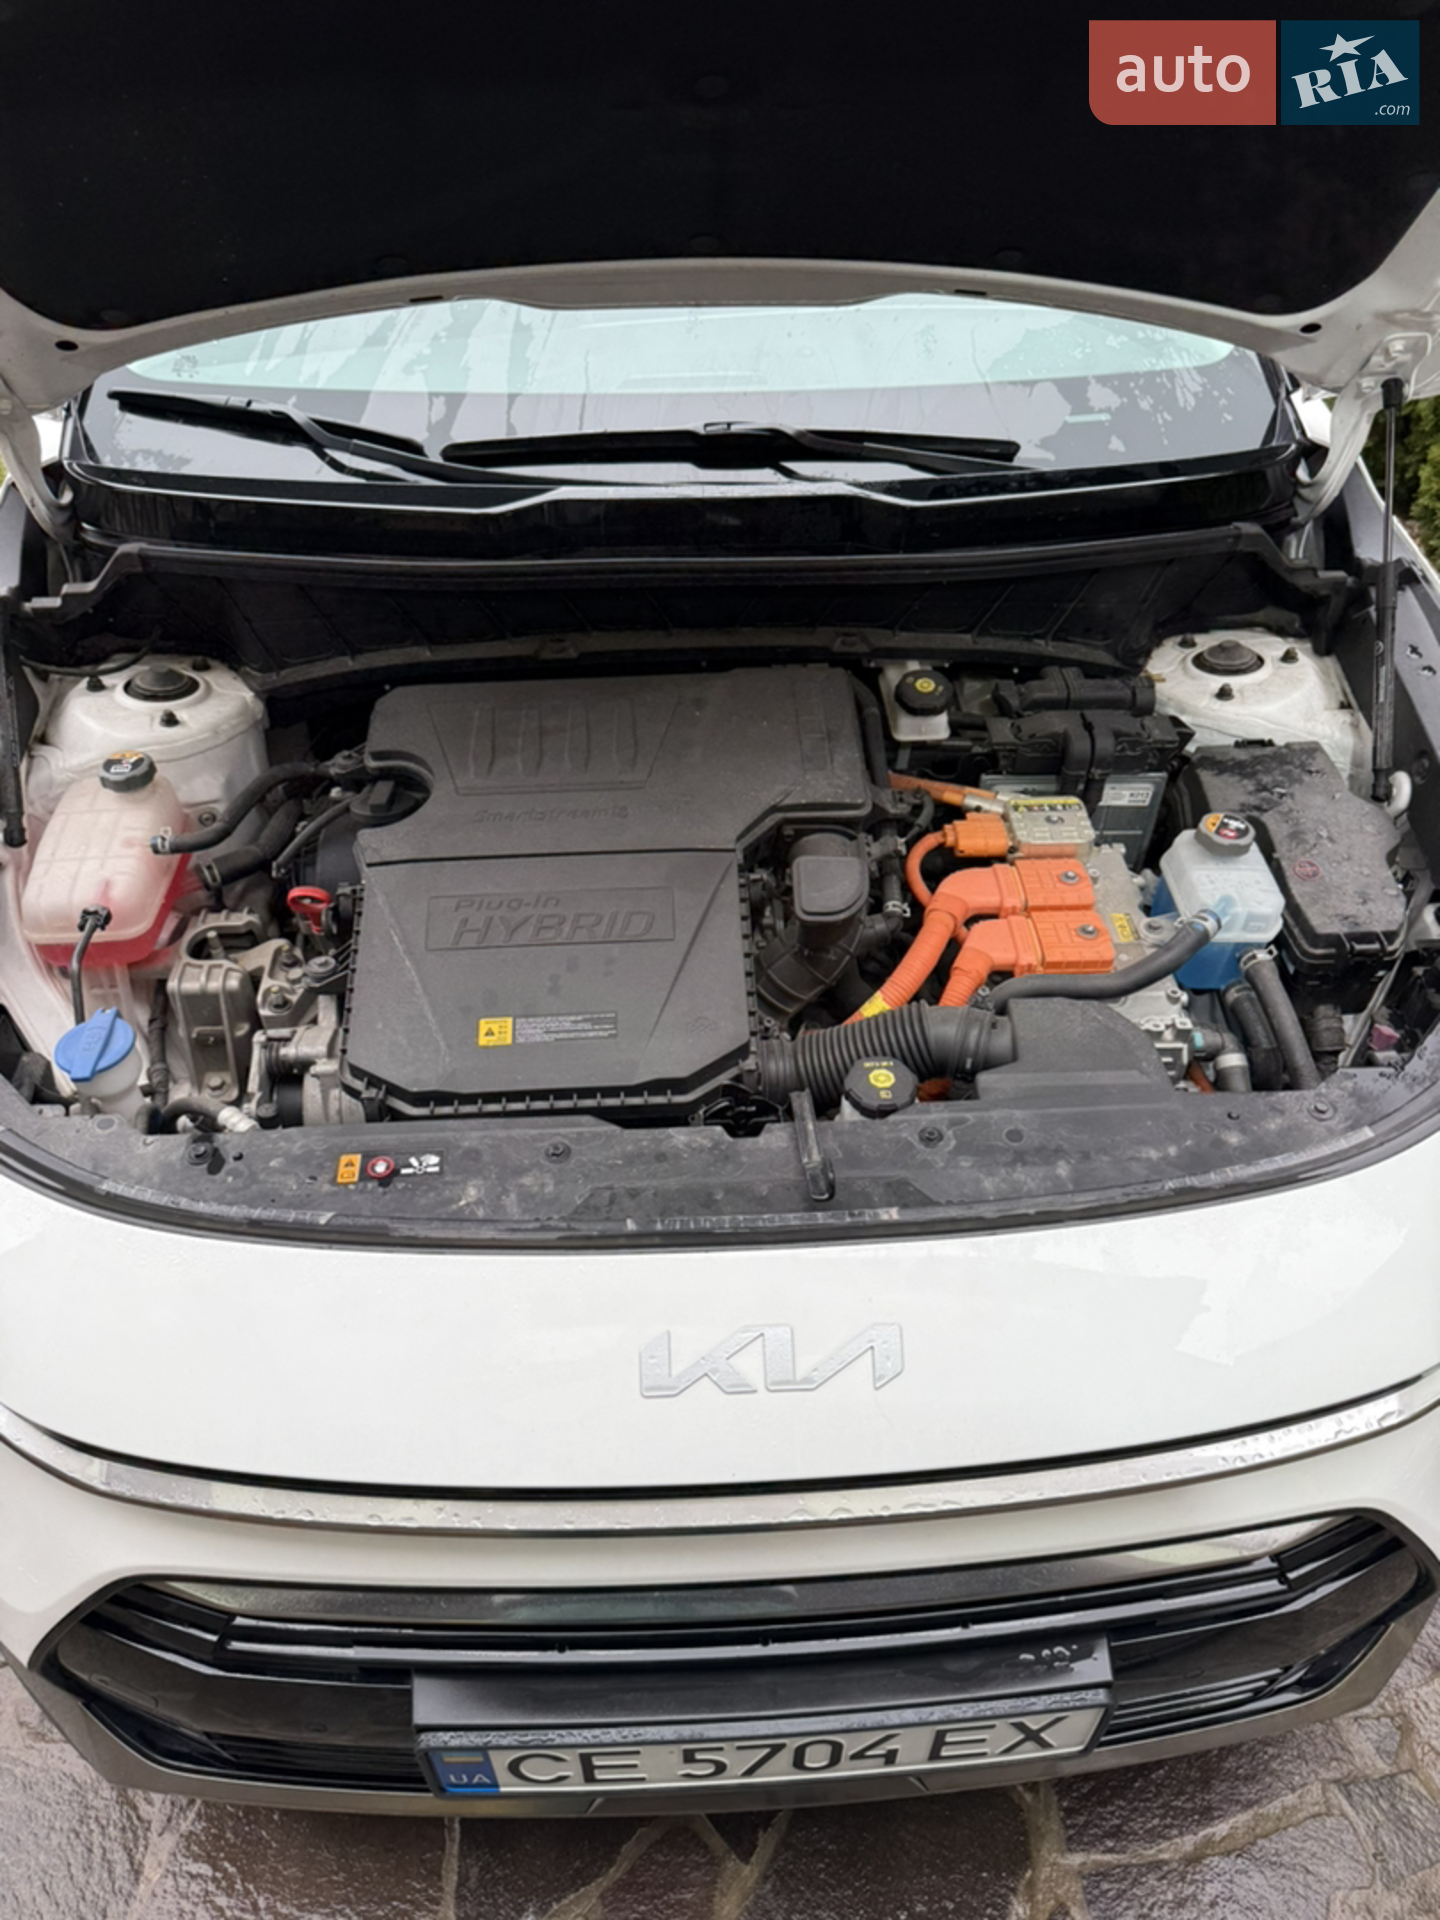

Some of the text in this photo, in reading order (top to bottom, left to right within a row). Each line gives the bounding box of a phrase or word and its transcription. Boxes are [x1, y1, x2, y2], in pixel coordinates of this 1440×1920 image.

[451, 910, 655, 946] HYBRID
[638, 1324, 904, 1398] KIA
[507, 1715, 1071, 1784] CE 5704 EX
[449, 1773, 492, 1785] UA
